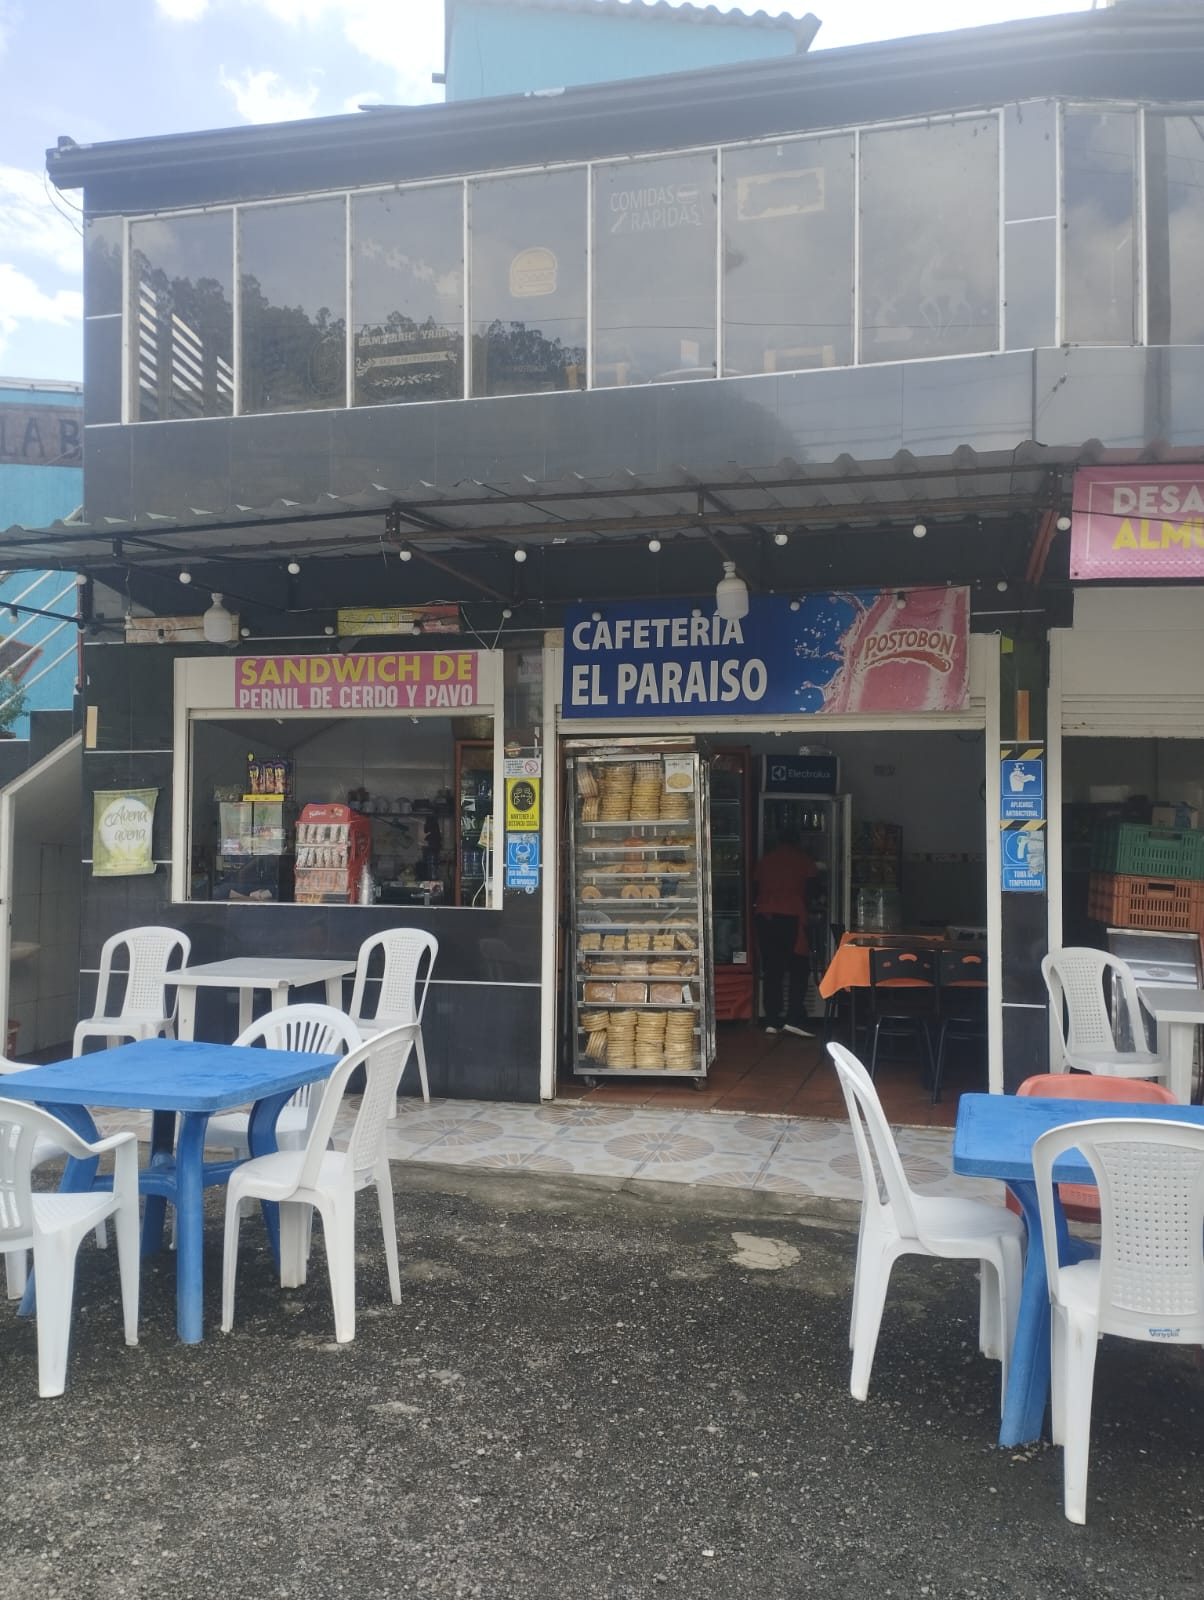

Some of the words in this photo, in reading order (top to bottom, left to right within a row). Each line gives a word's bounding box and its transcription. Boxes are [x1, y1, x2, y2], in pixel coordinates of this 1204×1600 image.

[609, 185, 674, 212] COMIDAS
[630, 205, 699, 231] RAPIDAS
[1112, 485, 1204, 514] DESA
[863, 630, 954, 661] POSTOBON
[241, 656, 420, 686] SANDWICH
[433, 654, 473, 681] DE
[571, 664, 609, 706] EL
[617, 658, 768, 705] PARAISO
[239, 688, 303, 709] PERNIL
[310, 687, 333, 708] DE
[339, 686, 398, 708] CERDO
[406, 685, 418, 707] Y
[425, 684, 473, 706] PAVO
[787, 768, 831, 779] Electrolux
